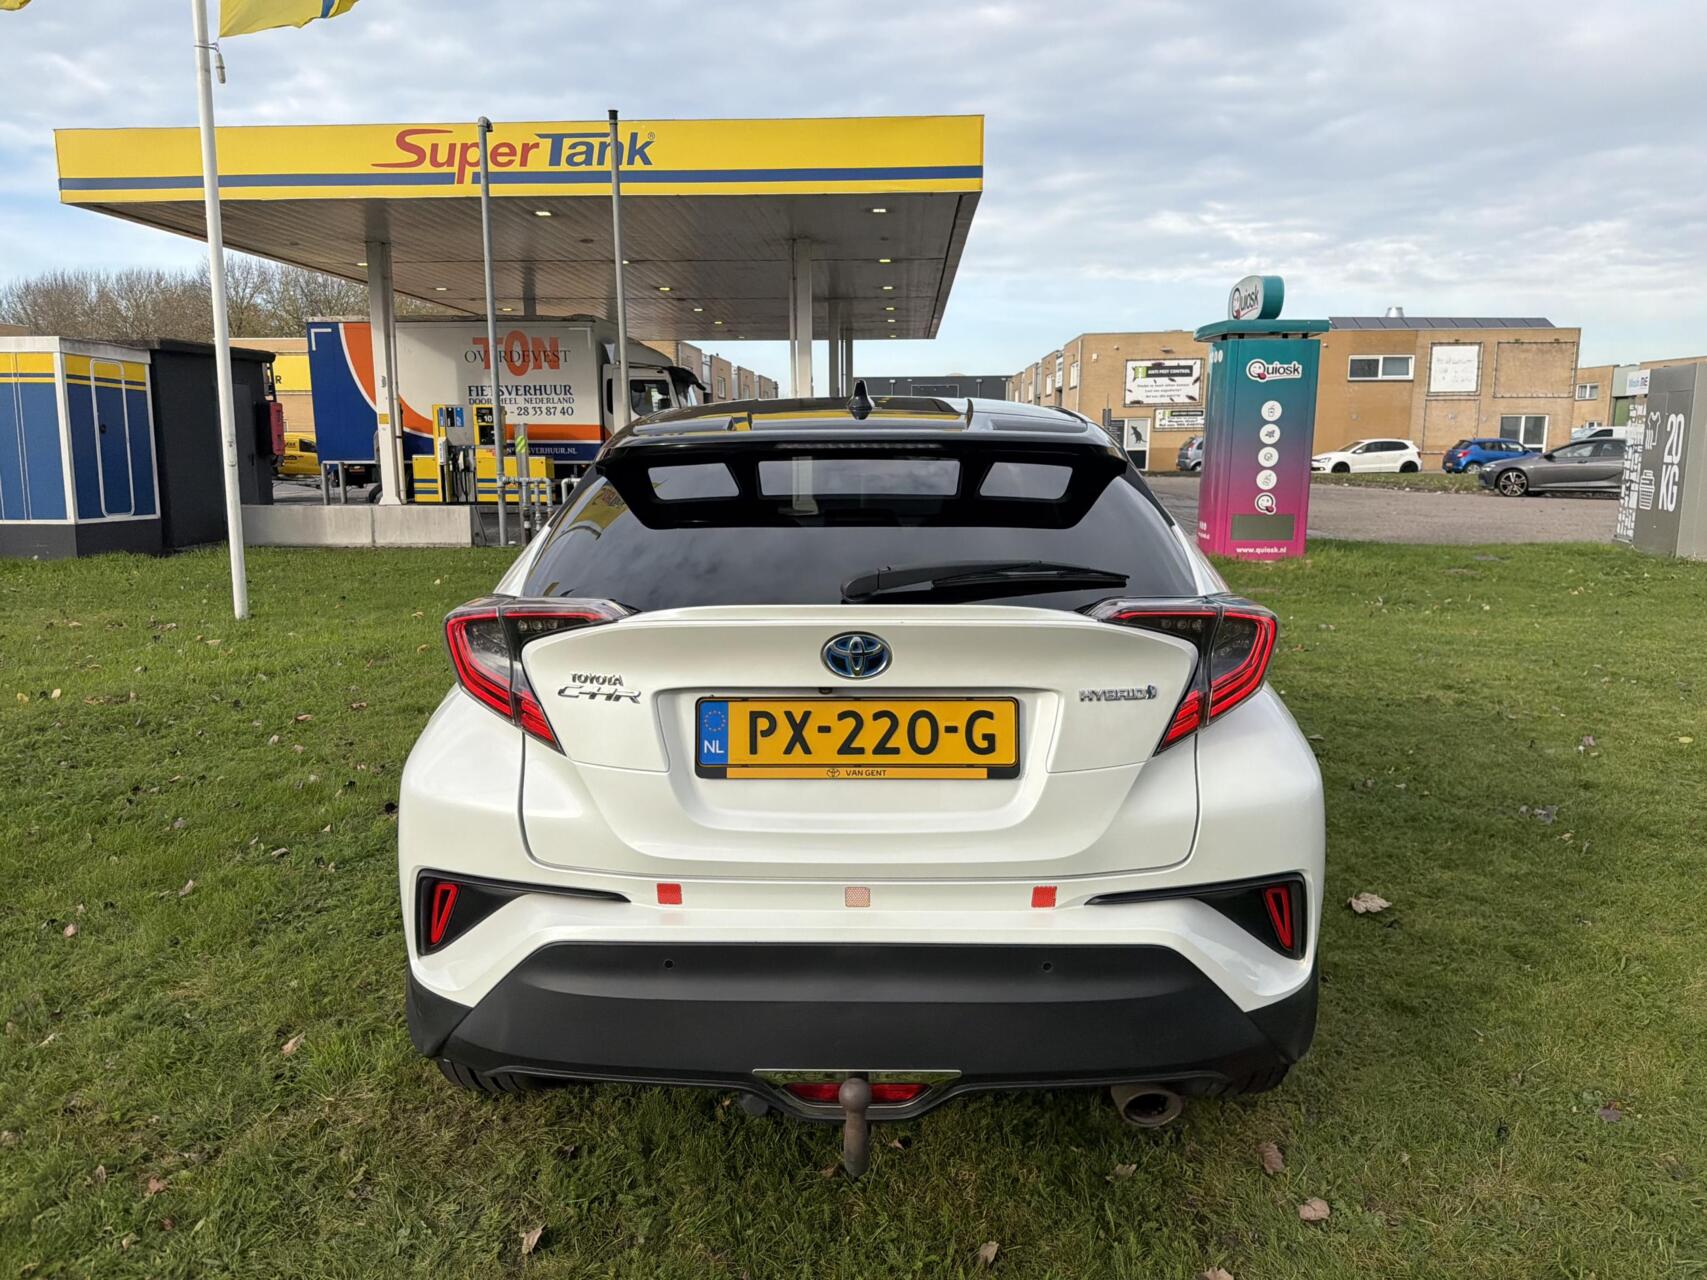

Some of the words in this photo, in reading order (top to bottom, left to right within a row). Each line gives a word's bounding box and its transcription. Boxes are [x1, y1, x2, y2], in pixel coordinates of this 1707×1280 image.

[1232, 284, 1259, 319] Quiosk
[464, 350, 571, 363] OVRDEVEST
[472, 330, 560, 376] TON
[1248, 361, 1300, 379] Quiosk
[523, 397, 574, 405] NEDERLAND
[517, 407, 529, 416] 28
[532, 407, 544, 416] 33
[545, 407, 557, 416] 87
[559, 406, 574, 416] 40
[1663, 413, 1685, 465] 20
[1658, 465, 1679, 512] KG
[571, 673, 624, 686] TOYOTA
[1079, 688, 1147, 702] HYBRID
[749, 709, 996, 755] PX-220-G
[704, 740, 724, 754] NL
[845, 769, 863, 777] VAN
[864, 769, 887, 777] GENT
